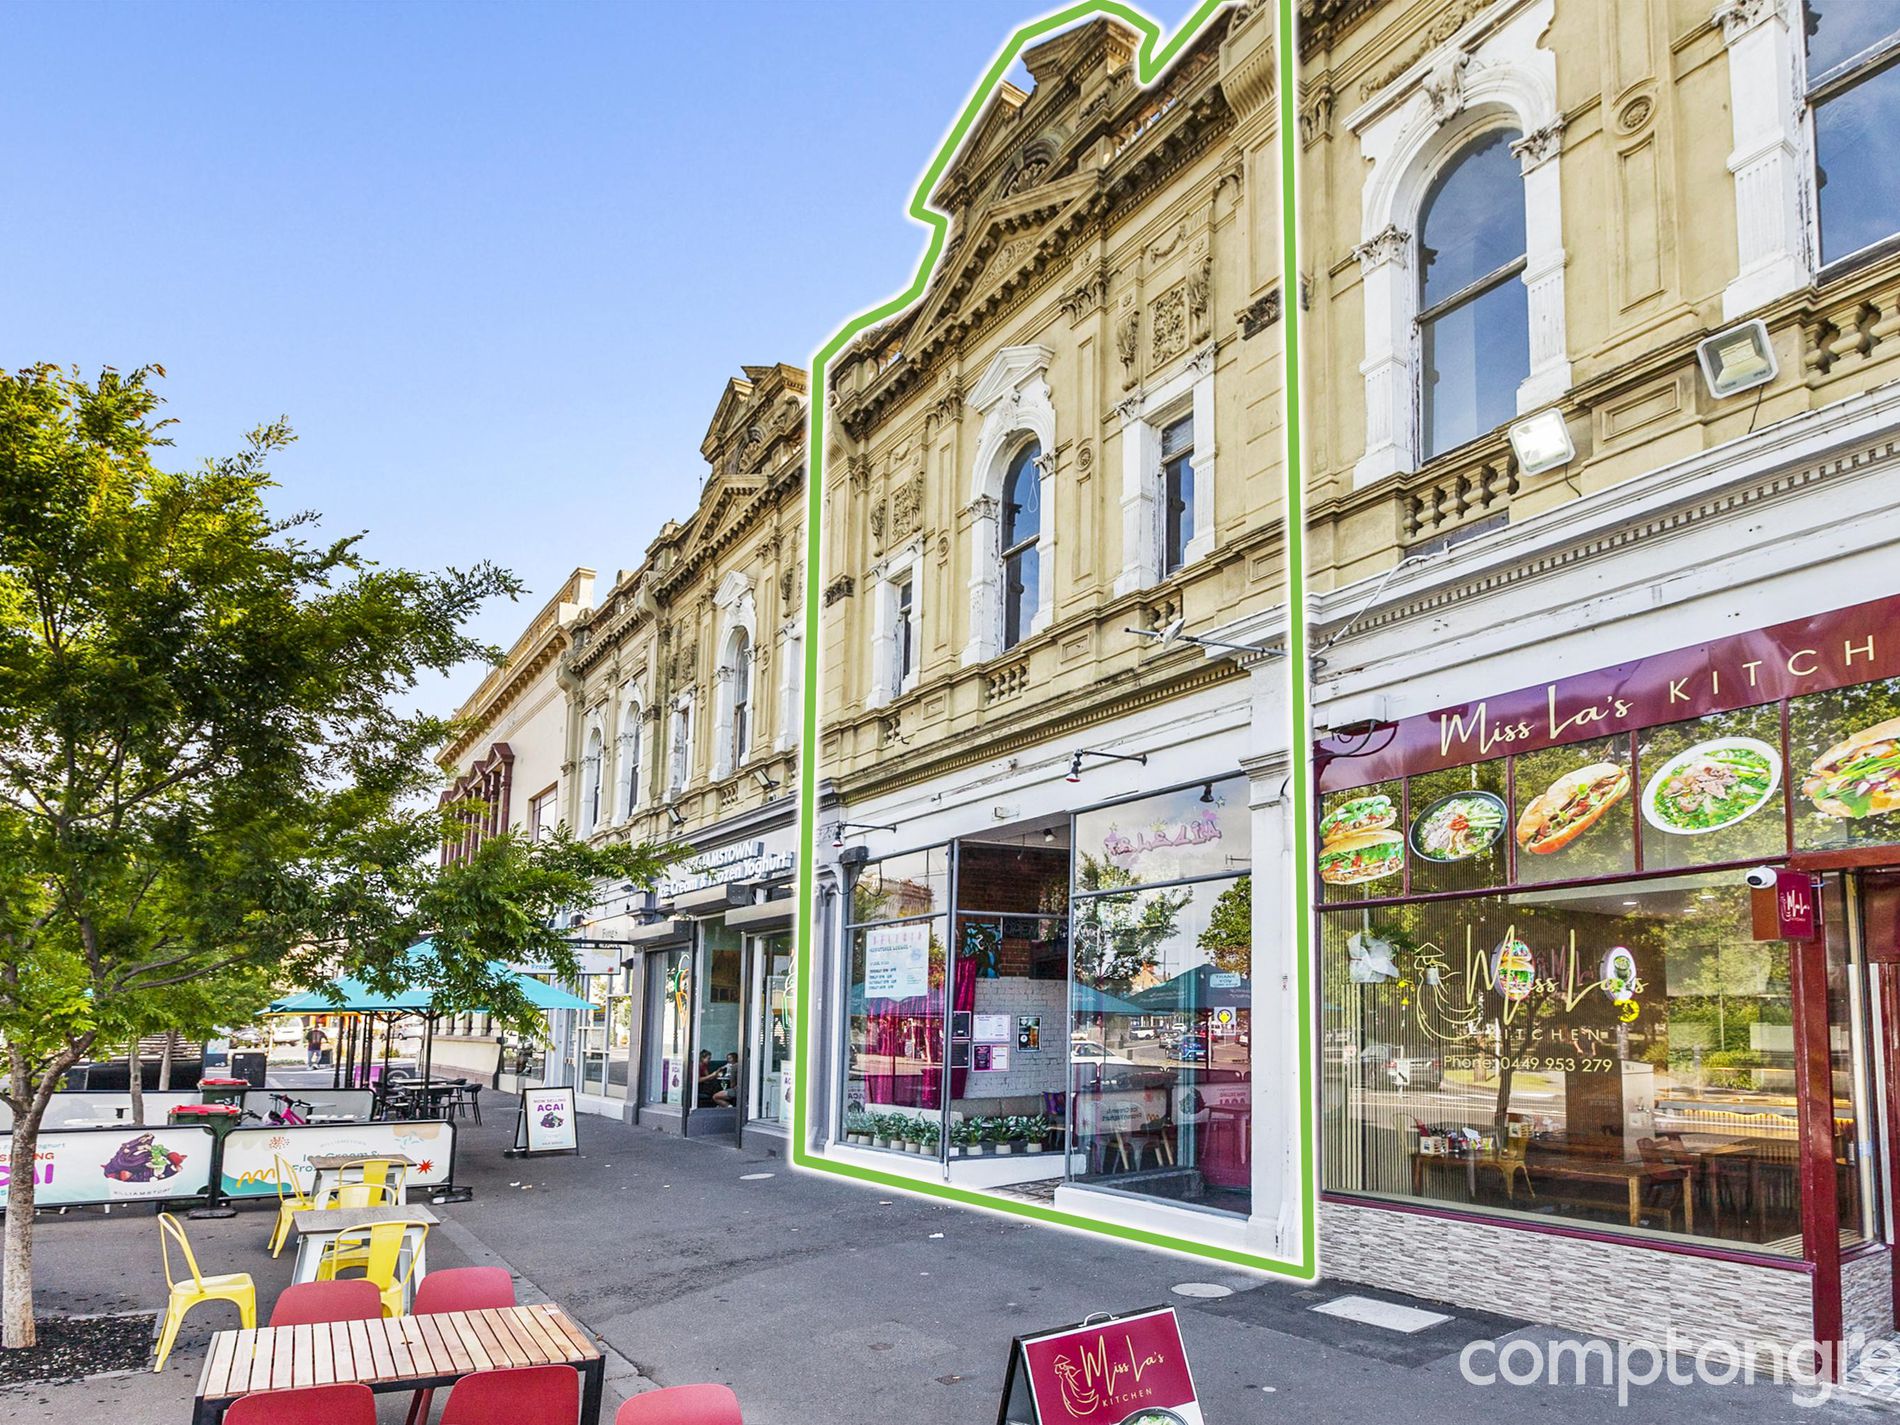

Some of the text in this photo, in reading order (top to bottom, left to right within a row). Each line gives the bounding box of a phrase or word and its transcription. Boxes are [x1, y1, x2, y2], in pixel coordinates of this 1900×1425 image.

[1441, 635, 1875, 756] Miss La's KITCH
[743, 852, 789, 879] Yoghurt
[1466, 924, 1560, 1026] Mss
[1501, 1057, 1540, 1070] 0449
[1545, 1057, 1576, 1072] 953
[1582, 1058, 1613, 1073] 279
[536, 1103, 564, 1112] ACAI
[1079, 1334, 1165, 1396] Miss La's
[1102, 1387, 1153, 1408] KITCHEN
